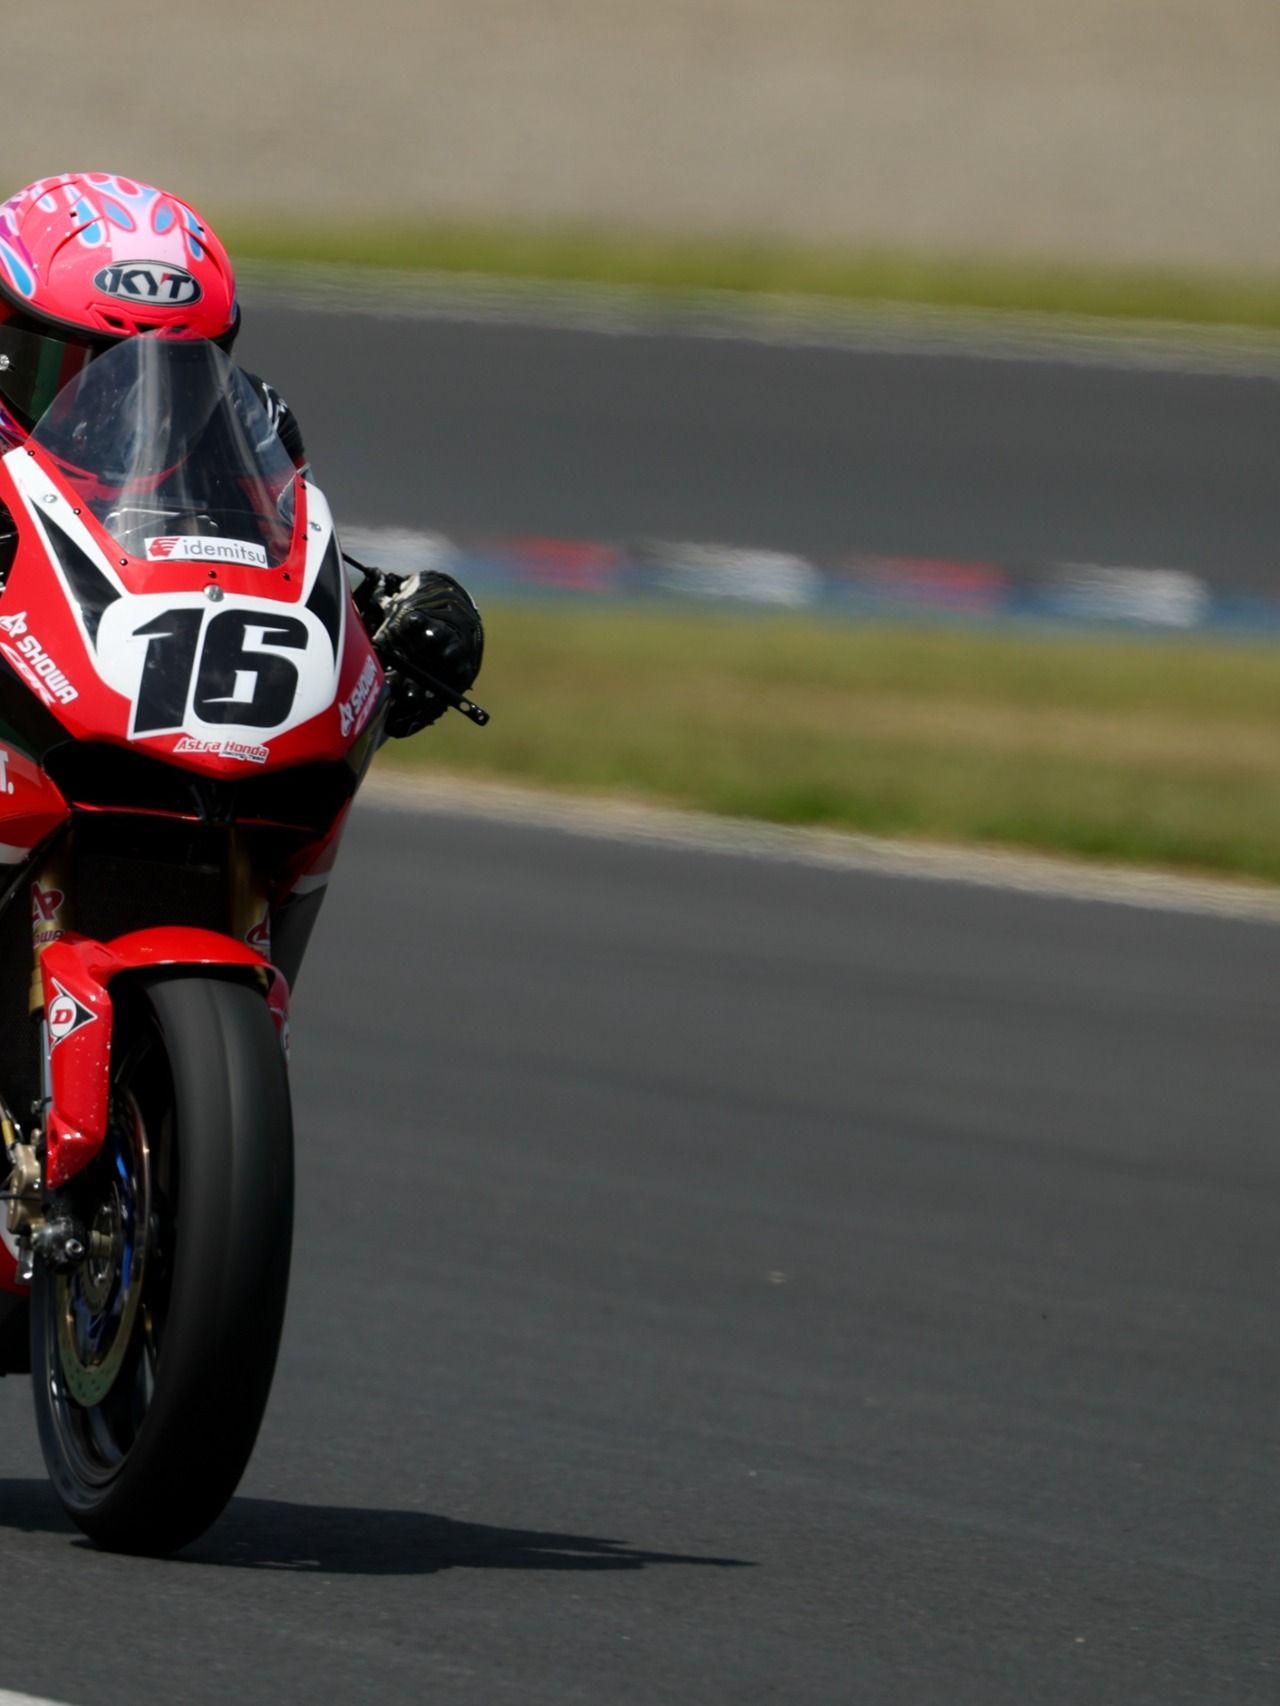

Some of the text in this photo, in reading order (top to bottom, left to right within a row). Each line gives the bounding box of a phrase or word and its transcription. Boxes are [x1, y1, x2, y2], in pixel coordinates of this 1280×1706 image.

[105, 267, 194, 300] KYT
[182, 539, 267, 565] idemitsu
[14, 634, 80, 706] SHOWA
[131, 607, 309, 734] 16
[177, 739, 268, 757] Astra Honda
